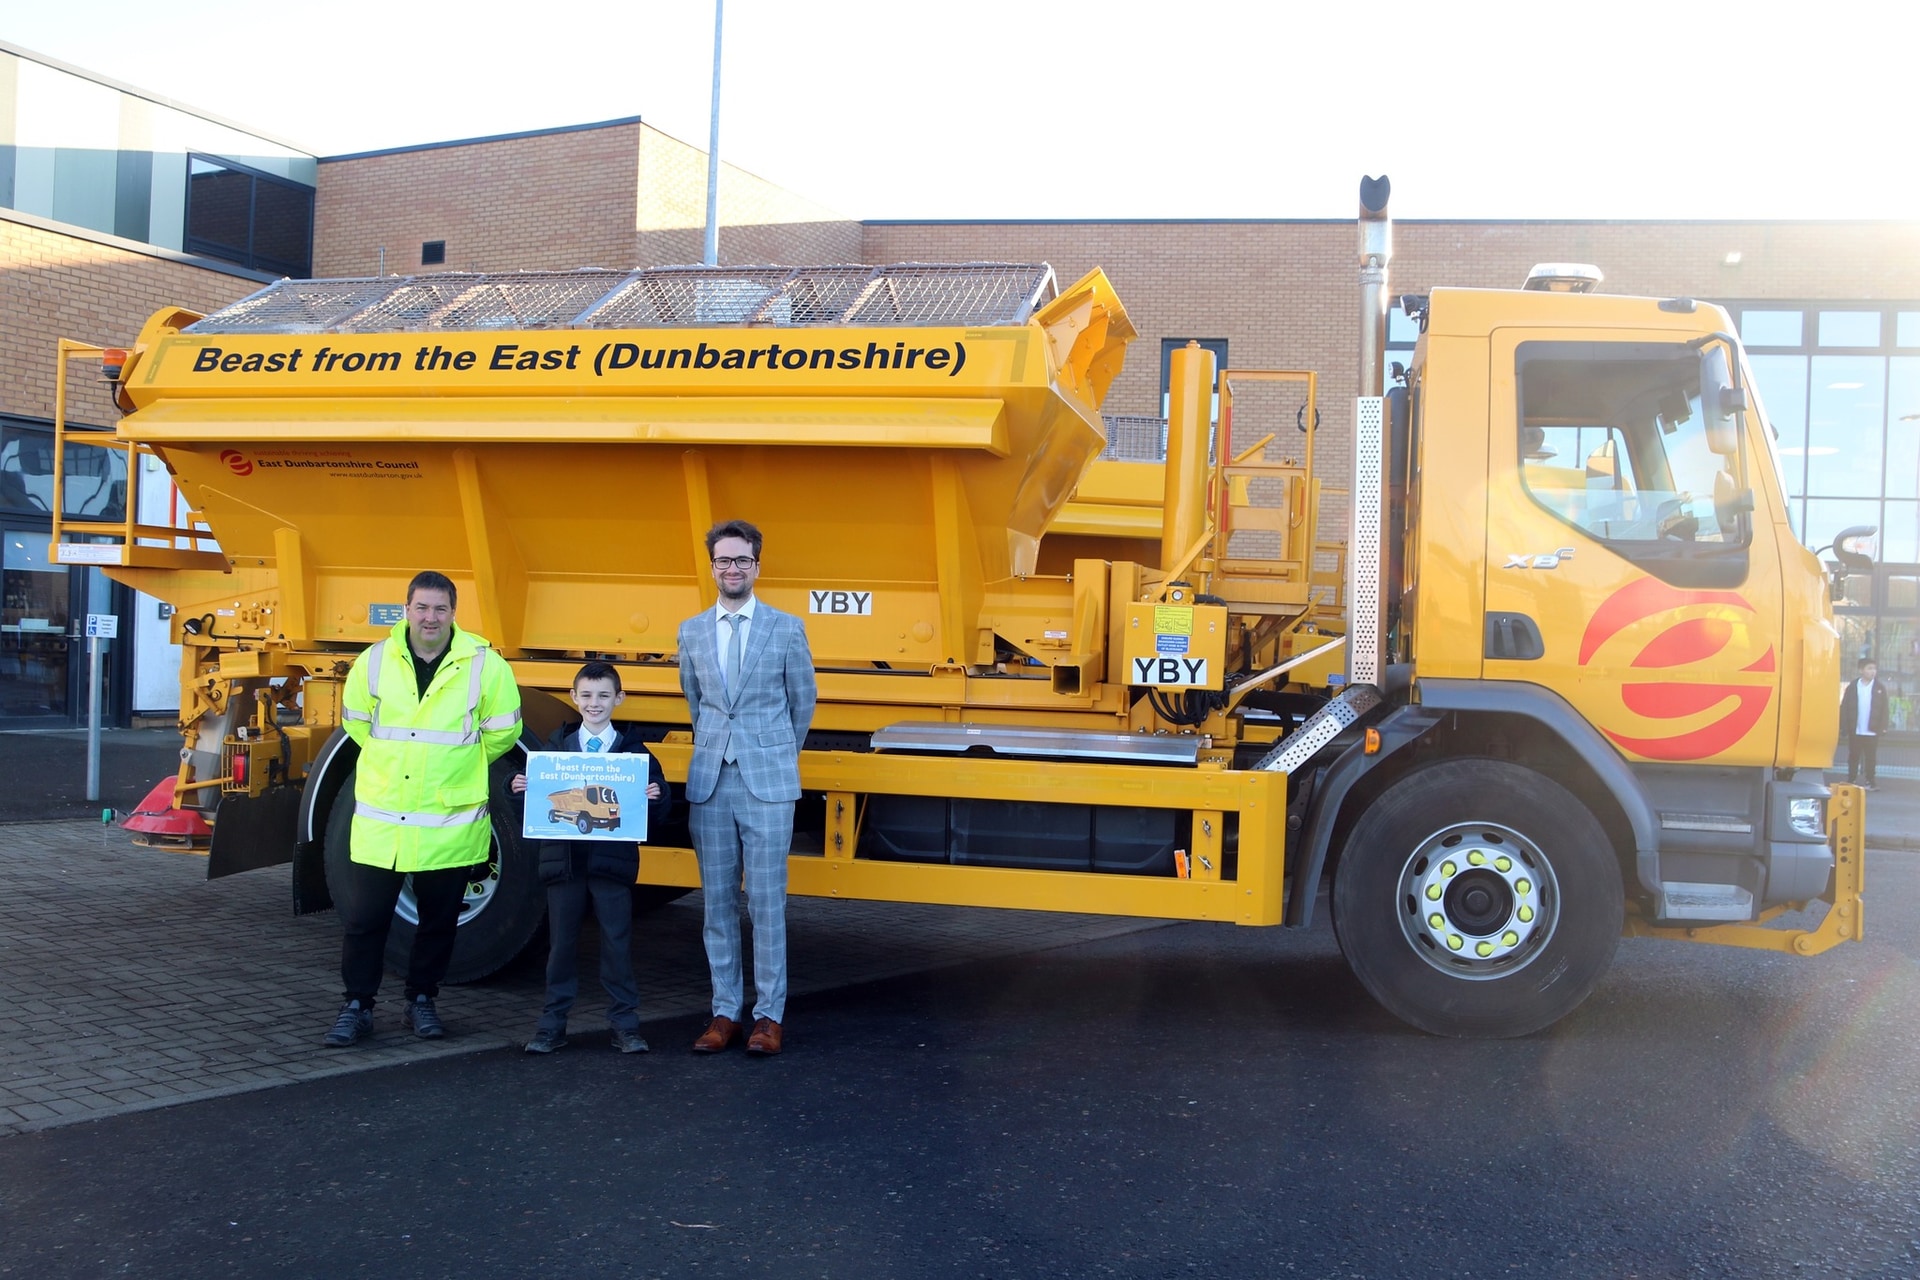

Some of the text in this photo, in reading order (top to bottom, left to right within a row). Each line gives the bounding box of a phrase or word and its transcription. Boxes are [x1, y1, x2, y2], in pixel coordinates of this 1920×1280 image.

[192, 341, 967, 377] Beast from the East (Dunbartonshire)
[257, 459, 419, 469] East Dunbartonshire Council
[811, 590, 870, 614] YBY
[1134, 658, 1205, 684] YBY
[555, 763, 621, 773] Beast from the
[540, 772, 636, 783] East (Dunbartonshire)
